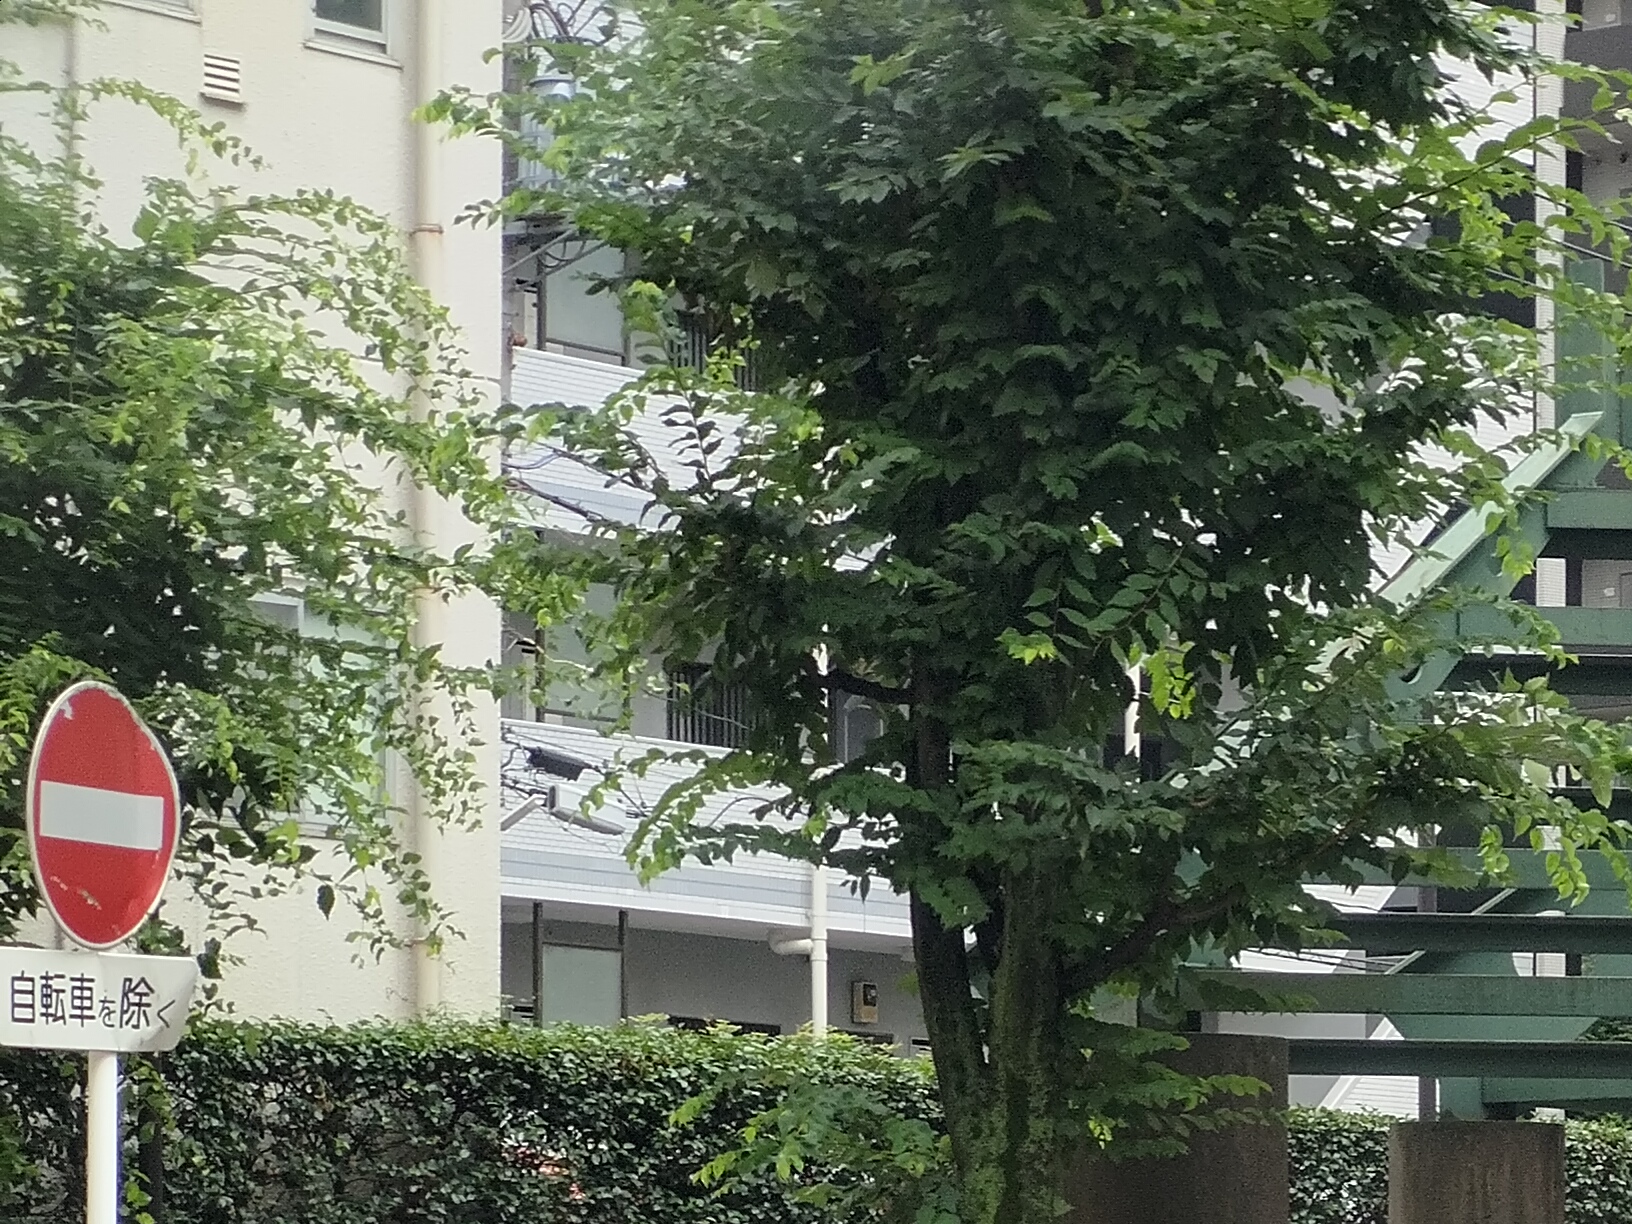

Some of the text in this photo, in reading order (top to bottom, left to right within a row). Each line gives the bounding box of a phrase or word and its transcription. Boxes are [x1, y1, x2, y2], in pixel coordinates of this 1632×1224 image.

[10, 969, 176, 1031] 自転車を除く
